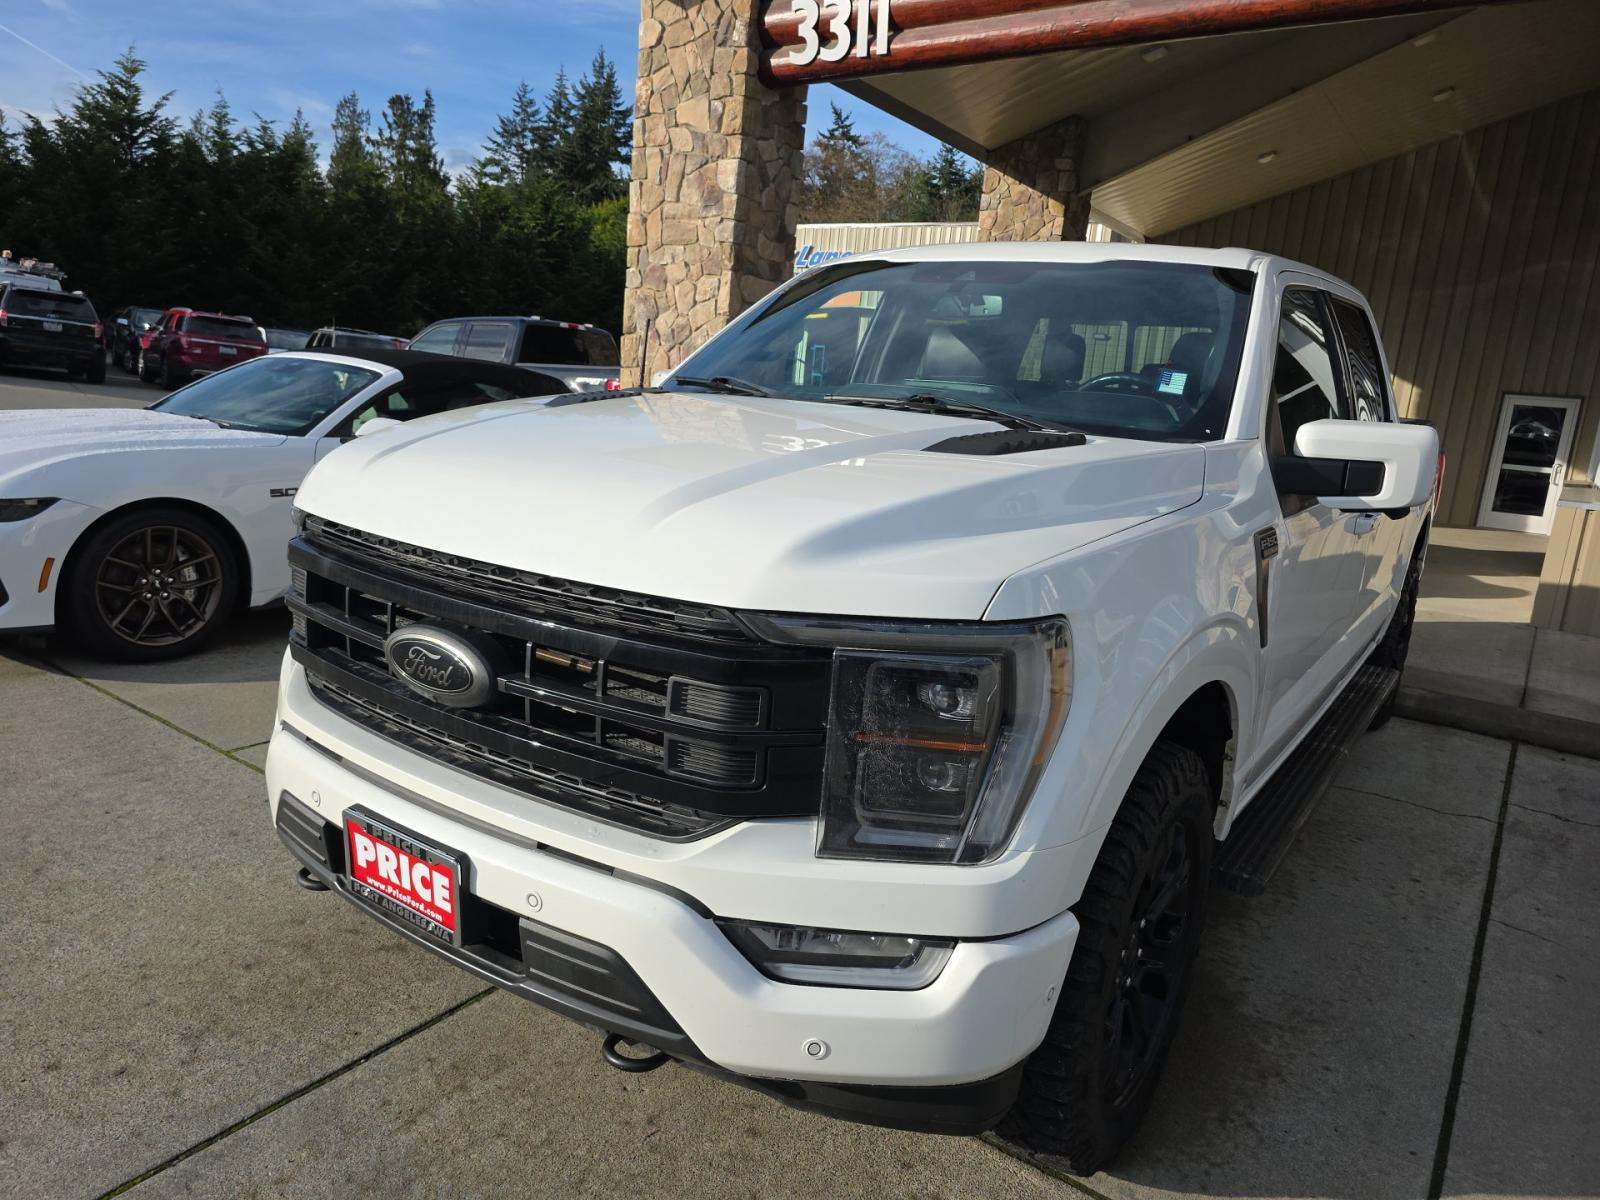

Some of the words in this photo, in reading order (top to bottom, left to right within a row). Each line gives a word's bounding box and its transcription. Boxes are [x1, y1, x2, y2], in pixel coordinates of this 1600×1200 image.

[788, 0, 890, 66] 3311
[404, 646, 454, 687] Ford
[353, 832, 452, 914] PRICE
